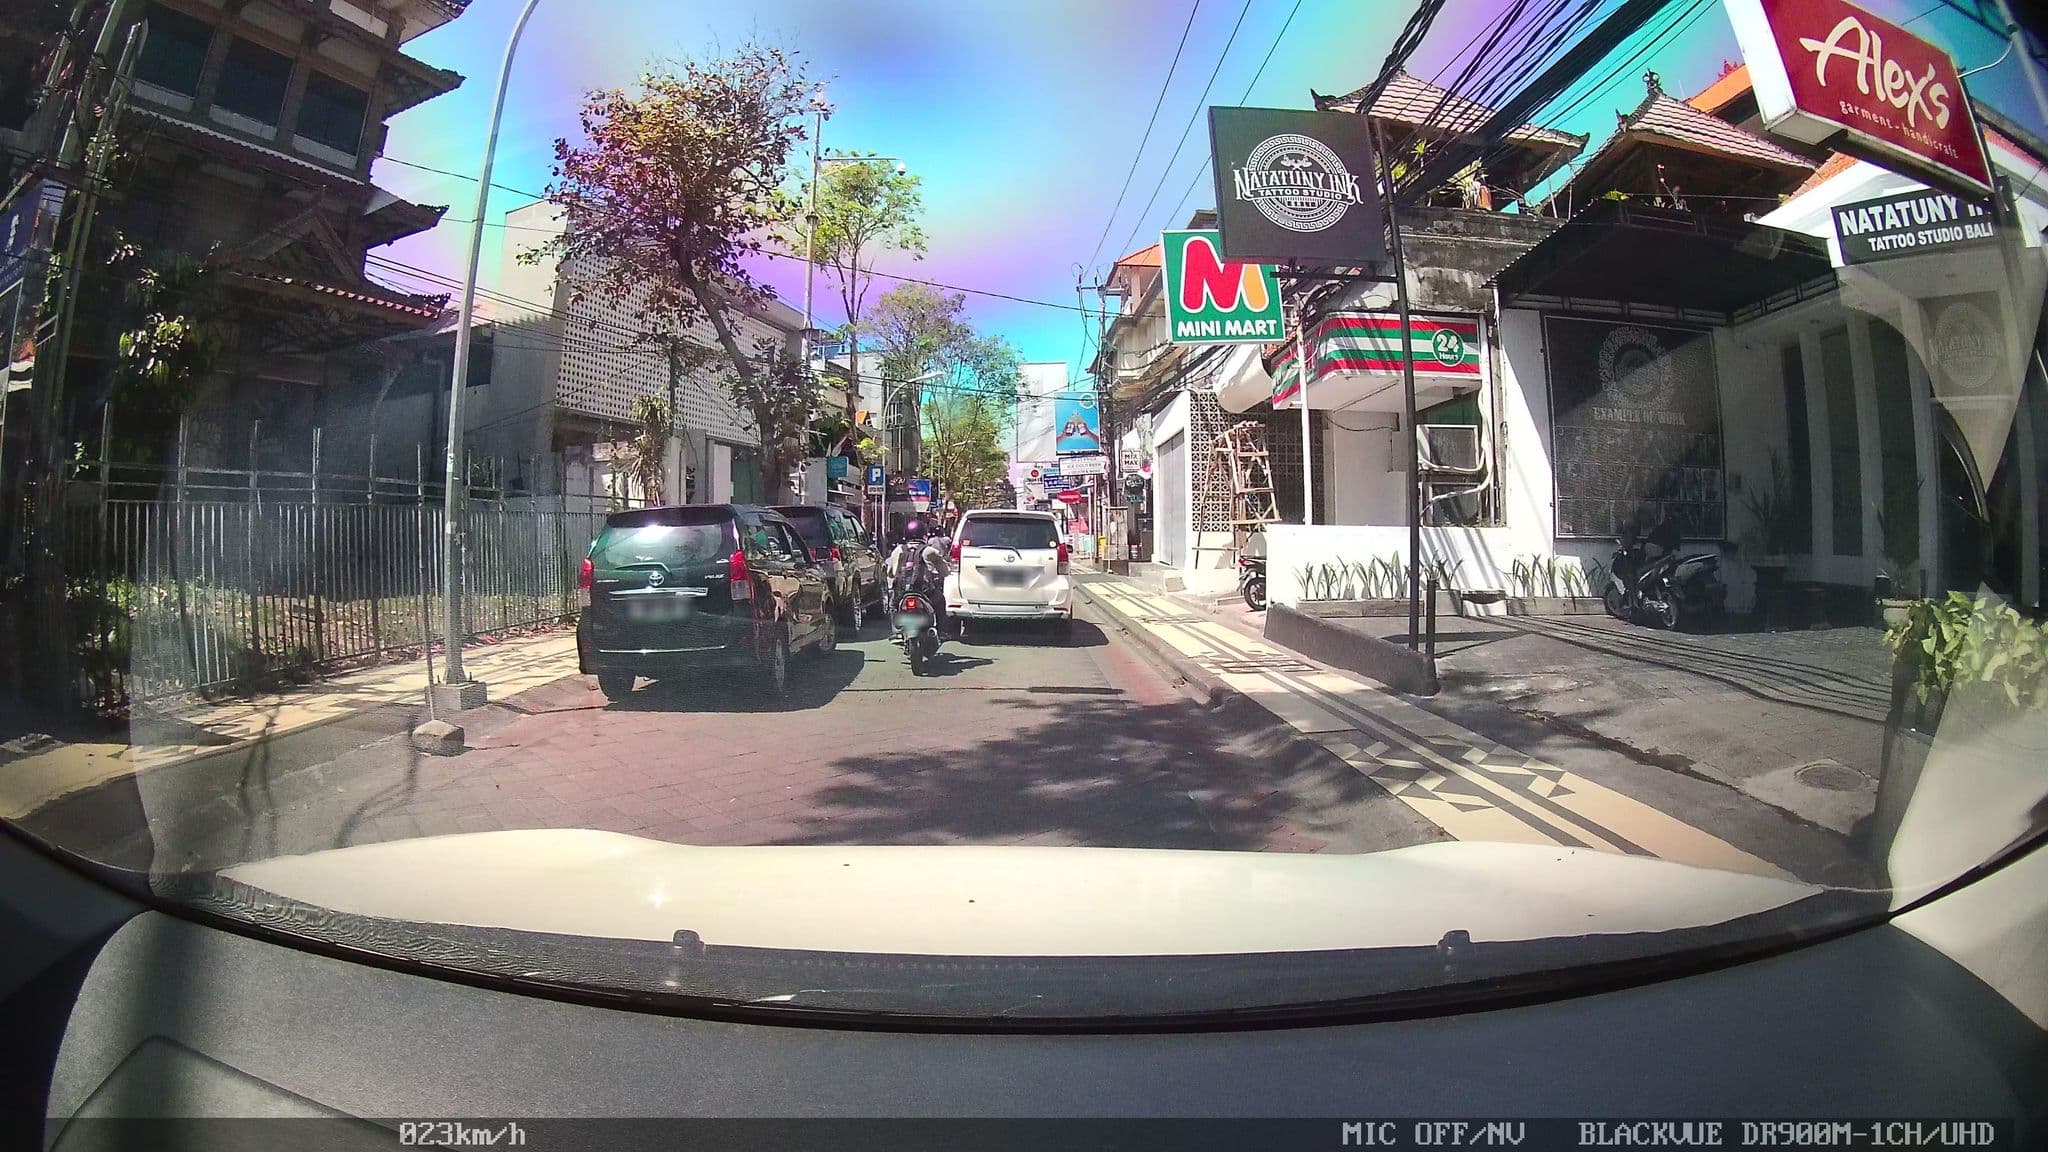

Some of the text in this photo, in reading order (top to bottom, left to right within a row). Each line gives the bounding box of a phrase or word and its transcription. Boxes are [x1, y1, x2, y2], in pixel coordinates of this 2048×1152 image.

[1839, 100, 1893, 130] garment
[1902, 123, 1959, 159] handicraft
[1233, 167, 1364, 205] NATATUNY INK
[1258, 188, 1343, 200] TATTOO STUDIO
[1839, 194, 1959, 237] NATATUNY
[1868, 222, 1994, 252] TATTOO STUDIO BALI
[1178, 319, 1277, 338] MINI MART
[1437, 334, 1459, 352] 24
[872, 468, 881, 482] P
